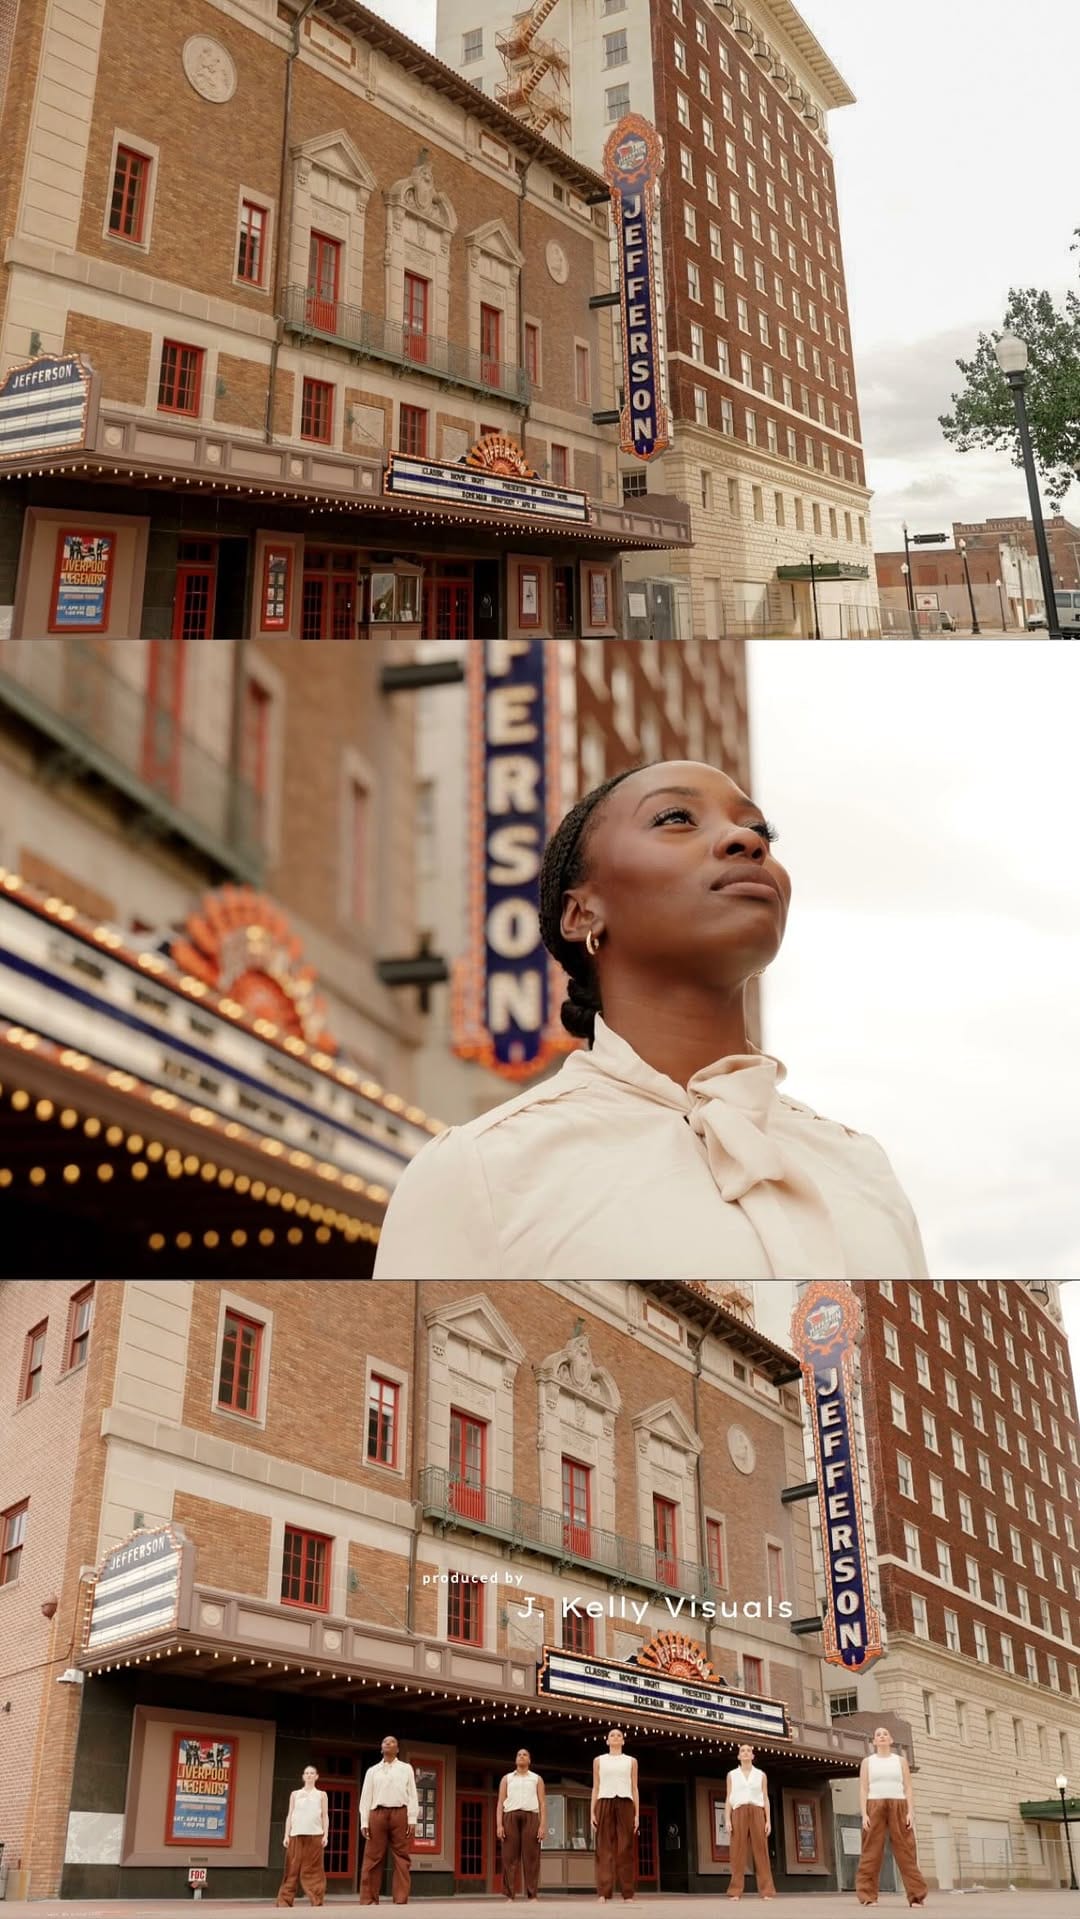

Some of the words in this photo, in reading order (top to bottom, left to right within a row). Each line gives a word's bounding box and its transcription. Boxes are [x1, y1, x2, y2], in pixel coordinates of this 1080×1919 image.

[624, 194, 652, 440] JEFFERSON
[12, 364, 72, 388] JEFFERSON
[479, 444, 528, 476] JEFFERSON
[61, 559, 107, 573] LIVERPOOL
[64, 573, 103, 585] LEGENDS
[816, 1368, 861, 1648] JEFFERSON
[110, 1536, 165, 1570] JEFFERSON
[656, 1644, 709, 1680] JEFFERSON
[584, 1666, 611, 1679] CLASSIC
[619, 1674, 638, 1685] MOVIE
[644, 1679, 660, 1689] NIGHT
[681, 1687, 711, 1701] PRESENTED
[717, 1695, 724, 1703] BY
[729, 1698, 746, 1708] EXXON
[633, 1695, 664, 1709] BOHEMIAN
[669, 1702, 698, 1715] RHAPSODY
[706, 1709, 717, 1719] APR
[176, 1764, 229, 1781] LIVERPOOL
[180, 1781, 224, 1795] LEGENDS
[191, 1870, 205, 1880] FDC
